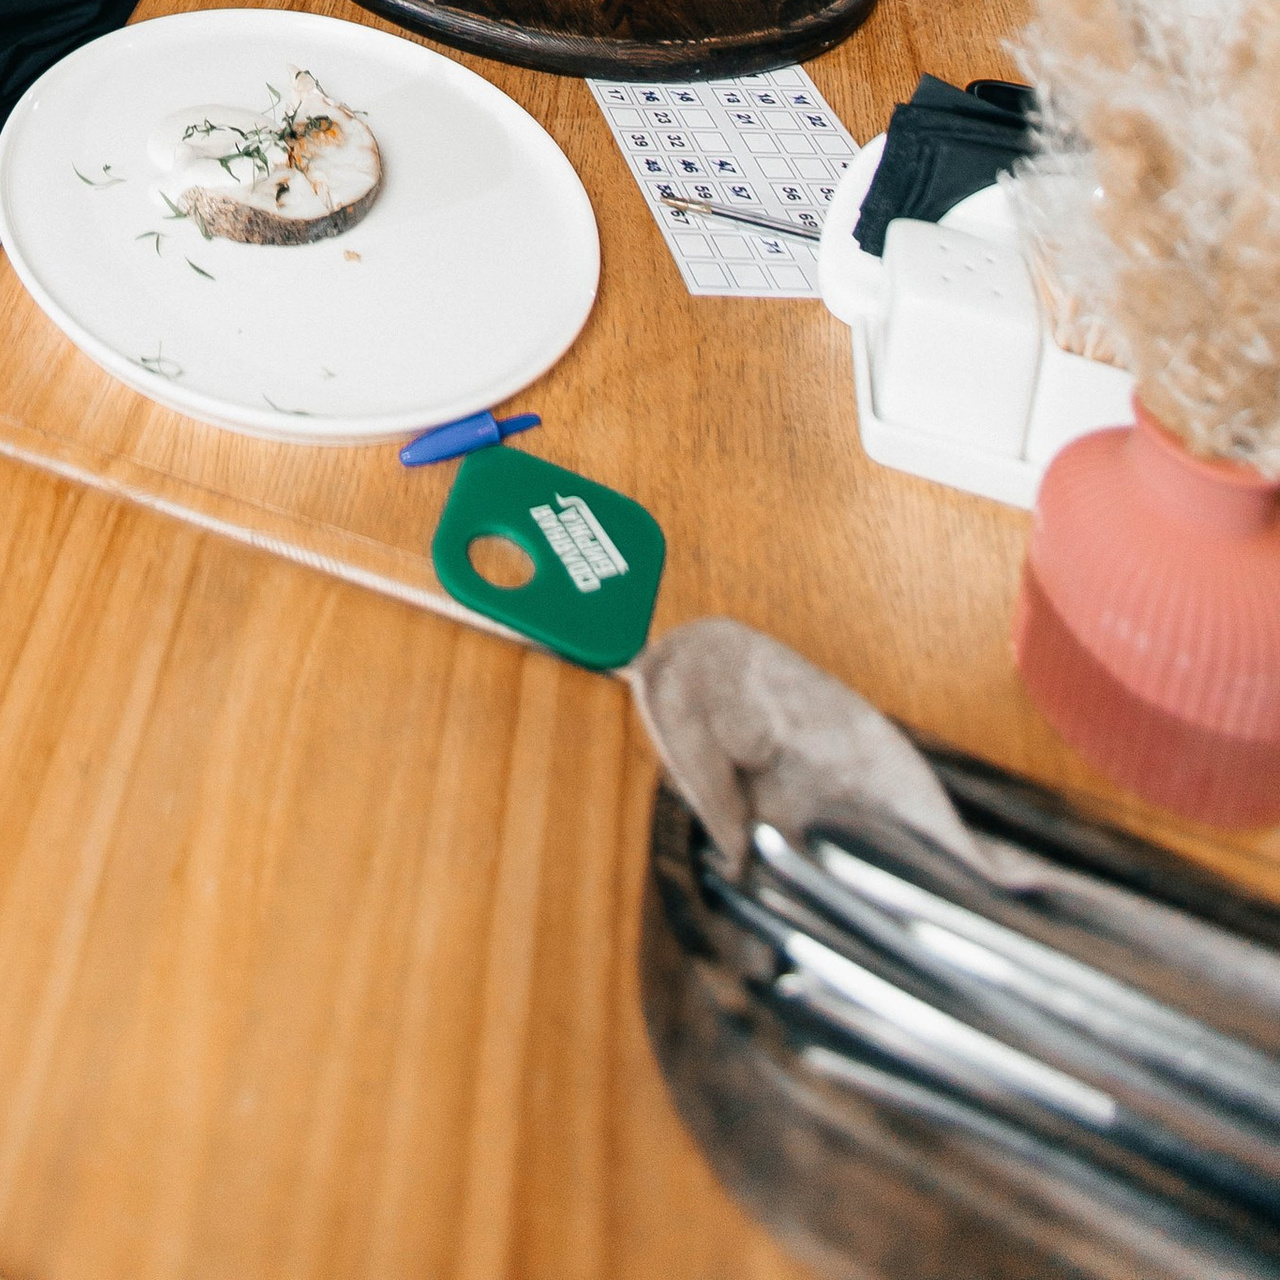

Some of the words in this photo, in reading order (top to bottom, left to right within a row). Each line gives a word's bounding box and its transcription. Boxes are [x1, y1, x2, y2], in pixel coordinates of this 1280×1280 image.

[757, 93, 776, 105] 10
[807, 115, 828, 127] 22
[608, 89, 625, 101] 17
[631, 134, 649, 147] 39
[670, 210, 690, 226] 67
[654, 111, 671, 124] 23
[667, 134, 685, 148] 32
[694, 185, 713, 199] 59
[723, 92, 741, 104] 13
[736, 113, 756, 125] 21
[782, 186, 802, 201] 56
[717, 159, 737, 174] 47
[732, 185, 752, 200] 57
